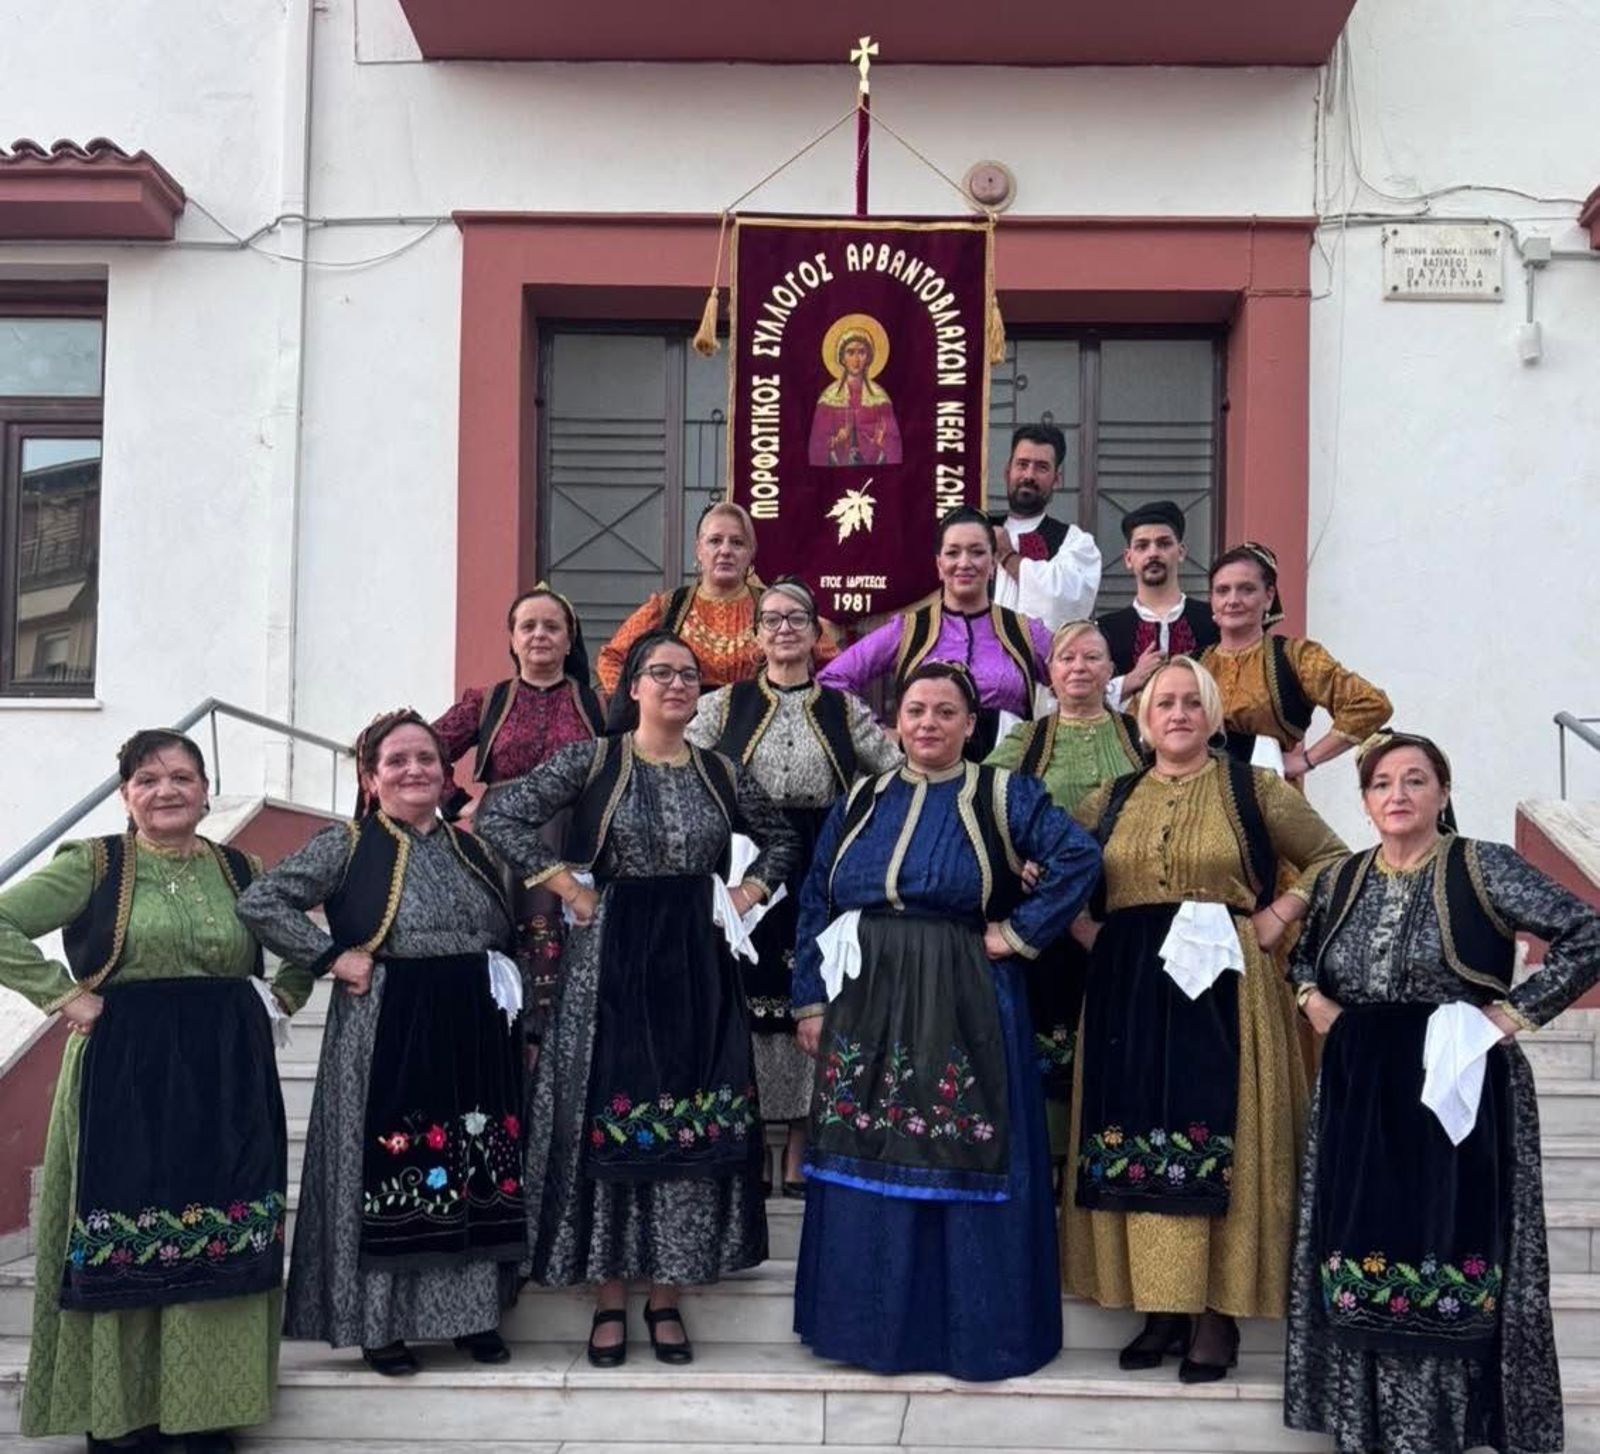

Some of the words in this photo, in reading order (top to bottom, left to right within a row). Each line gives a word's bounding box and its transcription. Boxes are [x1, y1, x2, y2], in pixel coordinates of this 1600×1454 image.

[753, 253, 834, 358] ΣΥΛΛΟΓΟΣ
[846, 243, 967, 386] ΑΡΒΑΝΤΟΒΛΑΧΩΝ
[751, 374, 780, 520] ΜΟΡΦΩΤΙΚΟΣ
[937, 402, 964, 452] ΝΕΑΣ
[821, 576, 842, 588] ΕΤΟΣ
[846, 576, 886, 588] ΙΔΡΥΣΕΩΣ
[834, 593, 871, 611] 1981
